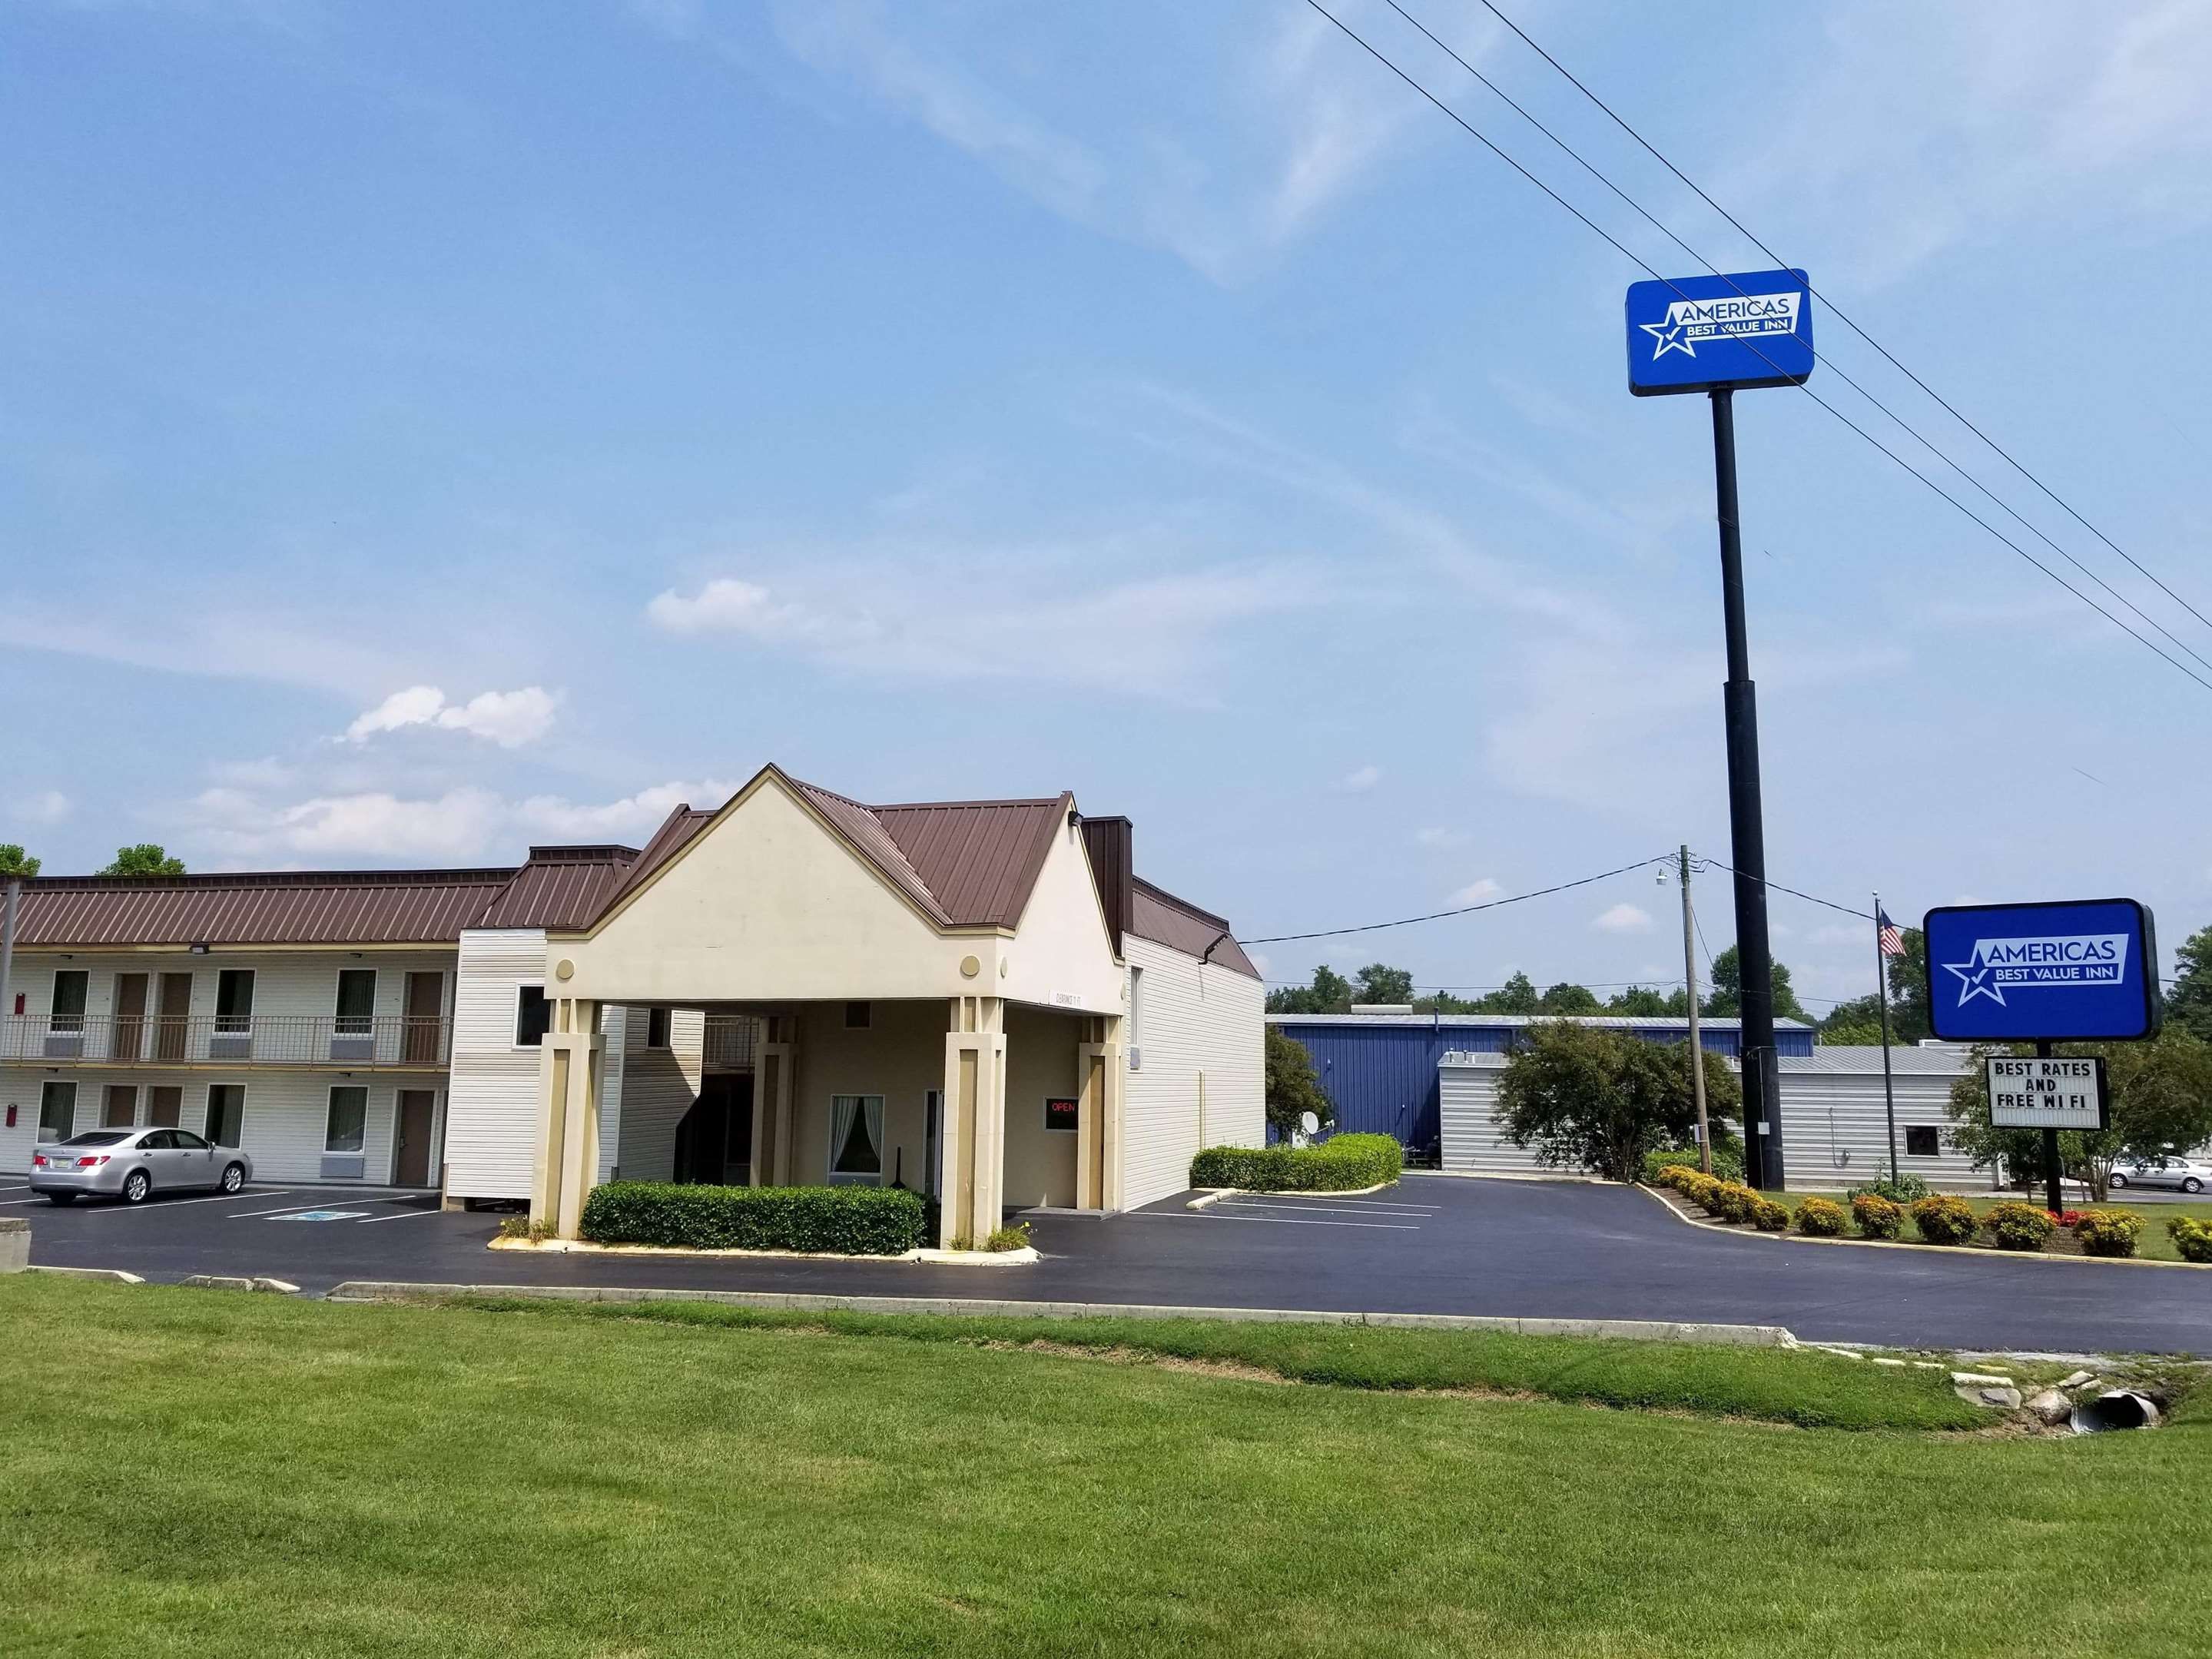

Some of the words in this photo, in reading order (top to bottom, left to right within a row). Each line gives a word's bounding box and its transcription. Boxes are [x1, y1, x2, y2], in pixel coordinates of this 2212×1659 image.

[1680, 298, 1790, 322] AMERICAS
[1686, 324, 1717, 337] BEST
[1721, 320, 1760, 333] VALUE
[1764, 319, 1789, 330] INN
[1987, 940, 2116, 964] AMERICAS
[1995, 968, 2030, 980] BEST
[2032, 967, 2080, 980] VALUE
[2085, 967, 2114, 978] INN
[1995, 1063, 2032, 1076] BEST
[2041, 1063, 2091, 1077] RATES
[2025, 1079, 2056, 1092] AND
[1997, 1093, 2035, 1107] FREE
[1052, 1103, 1075, 1112] OPEN
